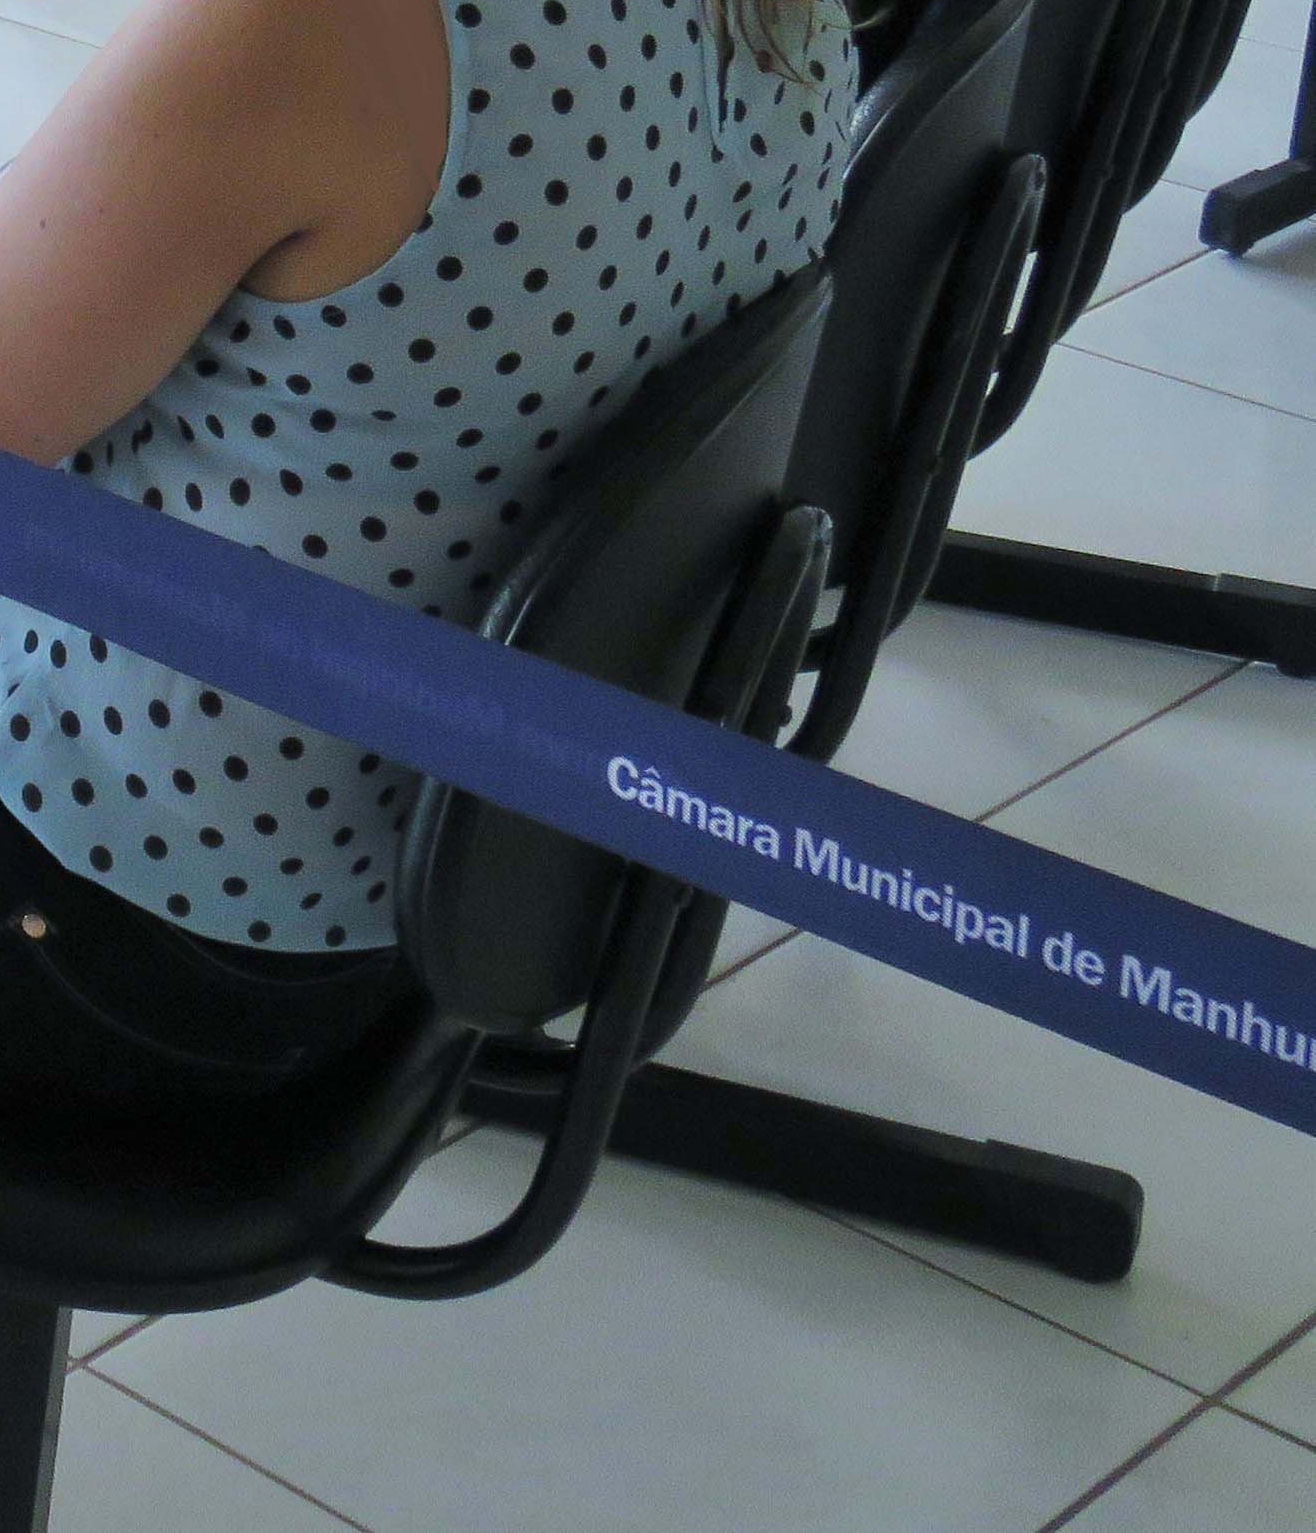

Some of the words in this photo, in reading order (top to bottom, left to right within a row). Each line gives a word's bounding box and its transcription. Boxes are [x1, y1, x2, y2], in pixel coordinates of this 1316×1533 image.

[607, 756, 779, 859] Câmara
[793, 827, 1029, 959] Municipal
[1041, 932, 1105, 986] de
[1120, 953, 1316, 1073] Manhu
